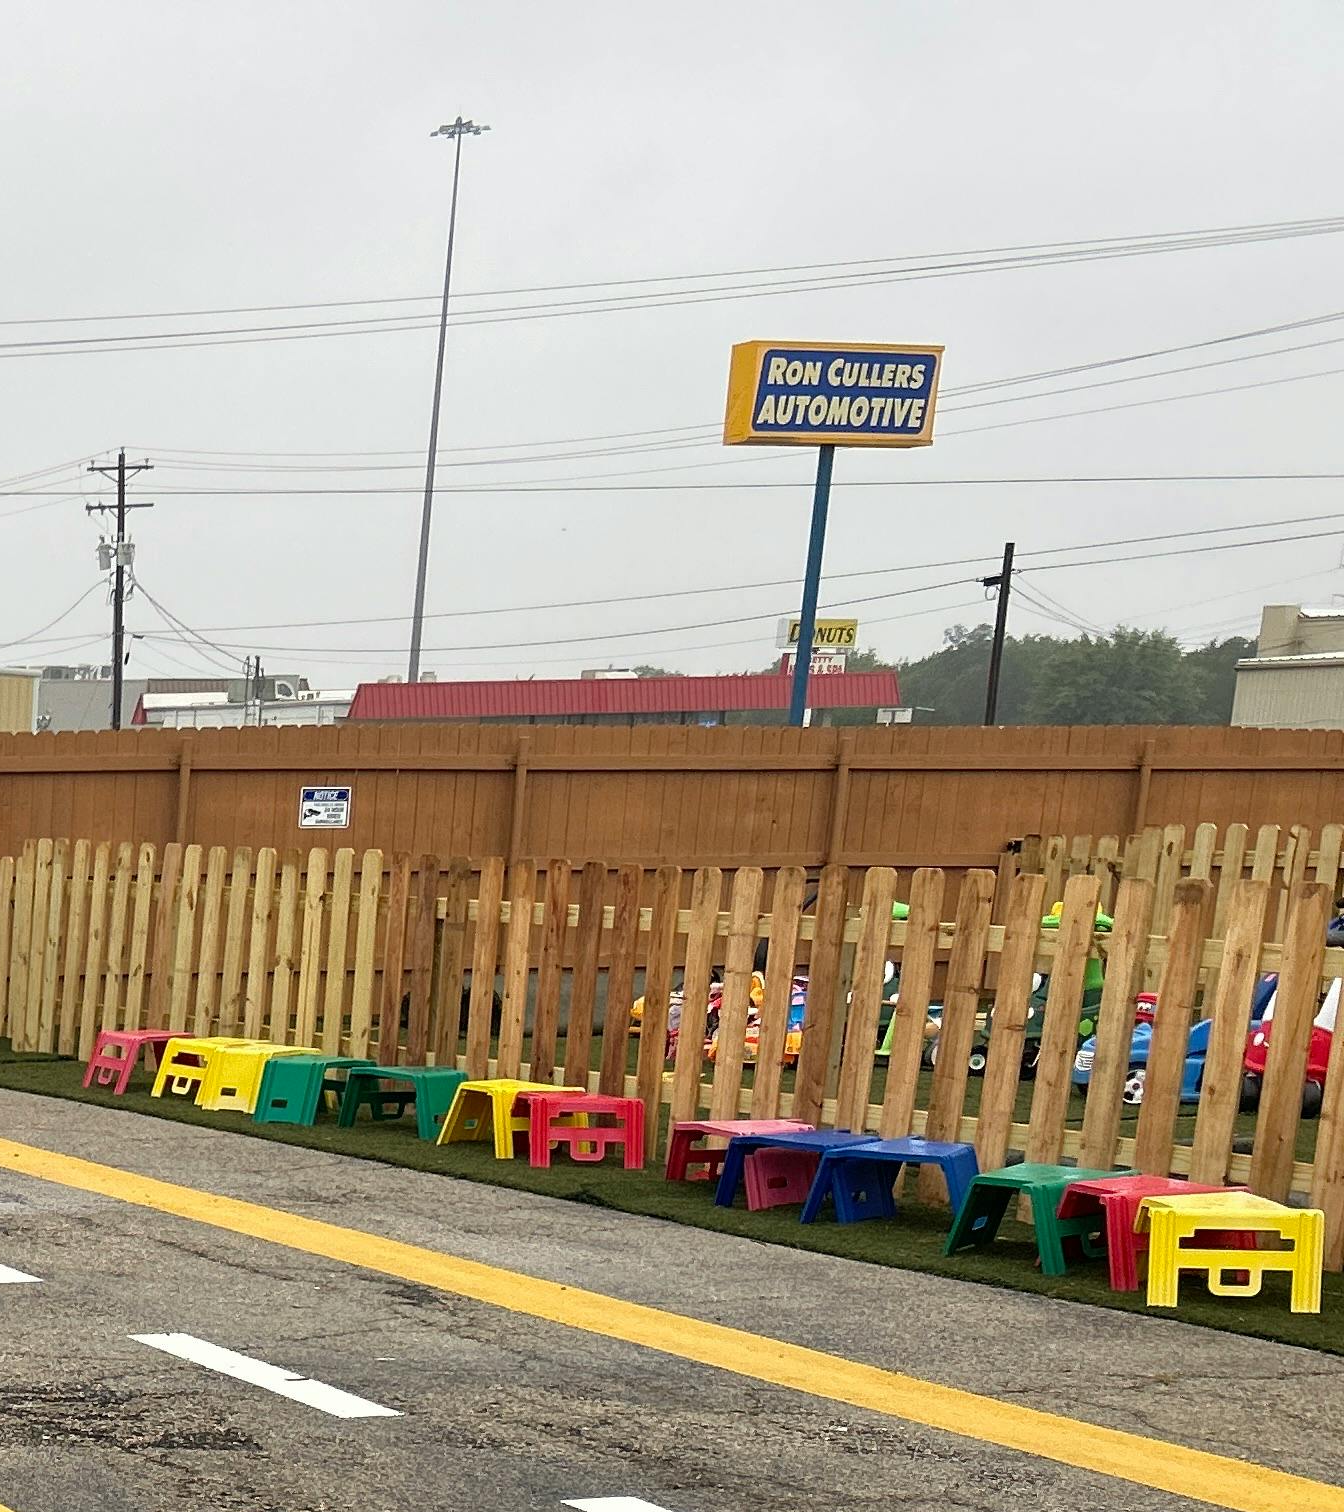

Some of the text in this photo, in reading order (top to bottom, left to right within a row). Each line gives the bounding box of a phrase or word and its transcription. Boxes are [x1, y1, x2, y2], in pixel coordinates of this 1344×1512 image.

[767, 357, 926, 390] RON CULLERS
[756, 394, 926, 429] AUTOMOTIVE
[788, 623, 855, 644] DNUTS
